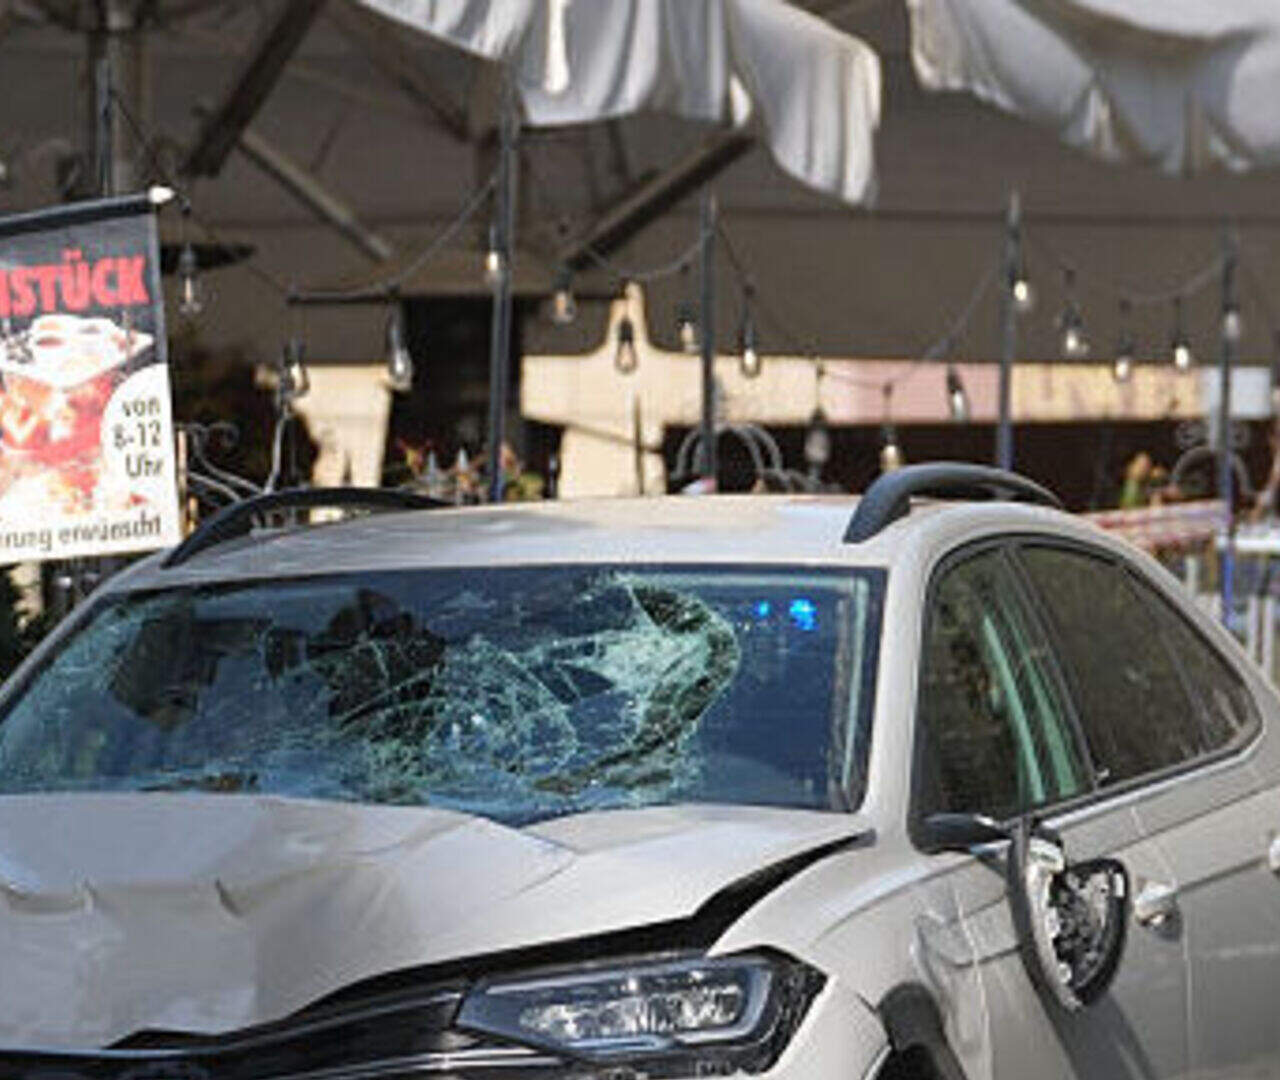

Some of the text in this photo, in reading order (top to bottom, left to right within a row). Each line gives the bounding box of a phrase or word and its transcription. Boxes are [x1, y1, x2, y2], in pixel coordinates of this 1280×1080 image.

[122, 396, 161, 418] von
[125, 452, 164, 479] Uhr
[58, 510, 162, 545] erwünscht
